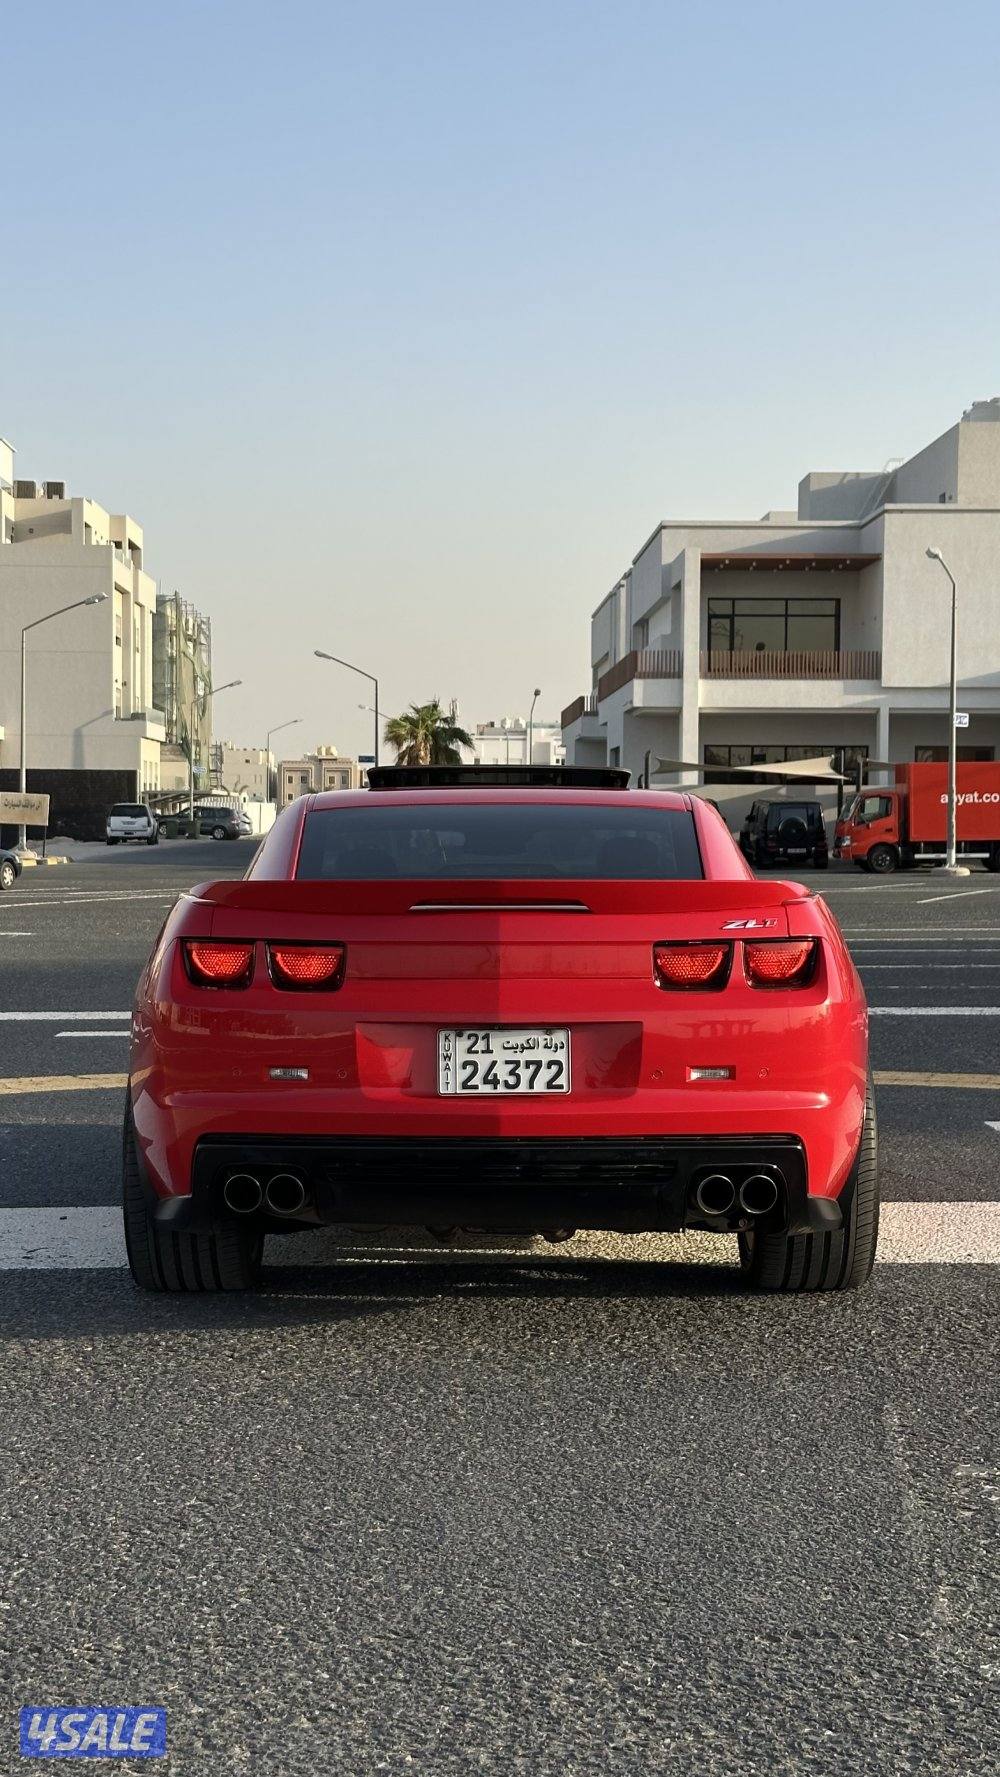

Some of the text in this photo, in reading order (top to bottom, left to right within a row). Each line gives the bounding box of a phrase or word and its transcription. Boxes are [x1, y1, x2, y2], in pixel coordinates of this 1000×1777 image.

[940, 791, 1000, 806] ayat.co
[720, 918, 779, 930] ZL1
[466, 1032, 494, 1055] 21
[502, 1036, 565, 1054] دولة الكويت
[442, 1033, 452, 1091] KUWAIT
[461, 1059, 565, 1090] 24372
